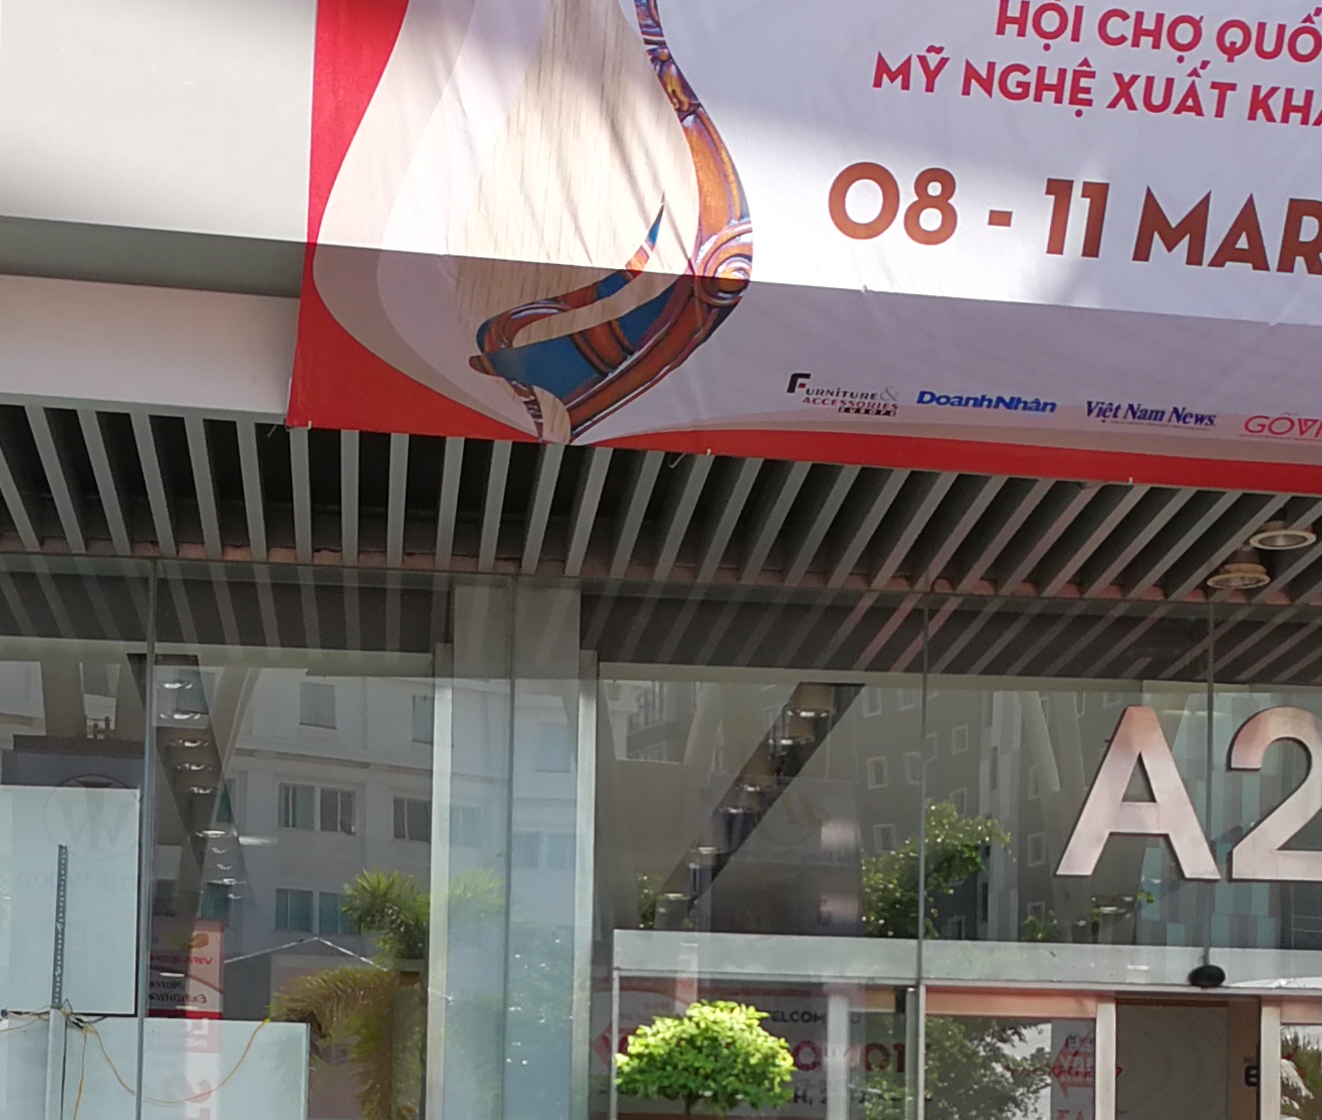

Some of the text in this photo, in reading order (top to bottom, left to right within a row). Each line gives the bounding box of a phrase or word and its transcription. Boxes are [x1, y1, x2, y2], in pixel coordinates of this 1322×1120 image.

[1097, 8, 1204, 63] CHỢ
[873, 44, 950, 93] MỸ
[961, 56, 1096, 118] NGHỆ
[1106, 60, 1237, 118] XUẤT
[827, 161, 958, 246] 08
[1042, 177, 1110, 259] 11
[802, 397, 898, 411] ACCESSORIES
[1123, 403, 1166, 422] Nam
